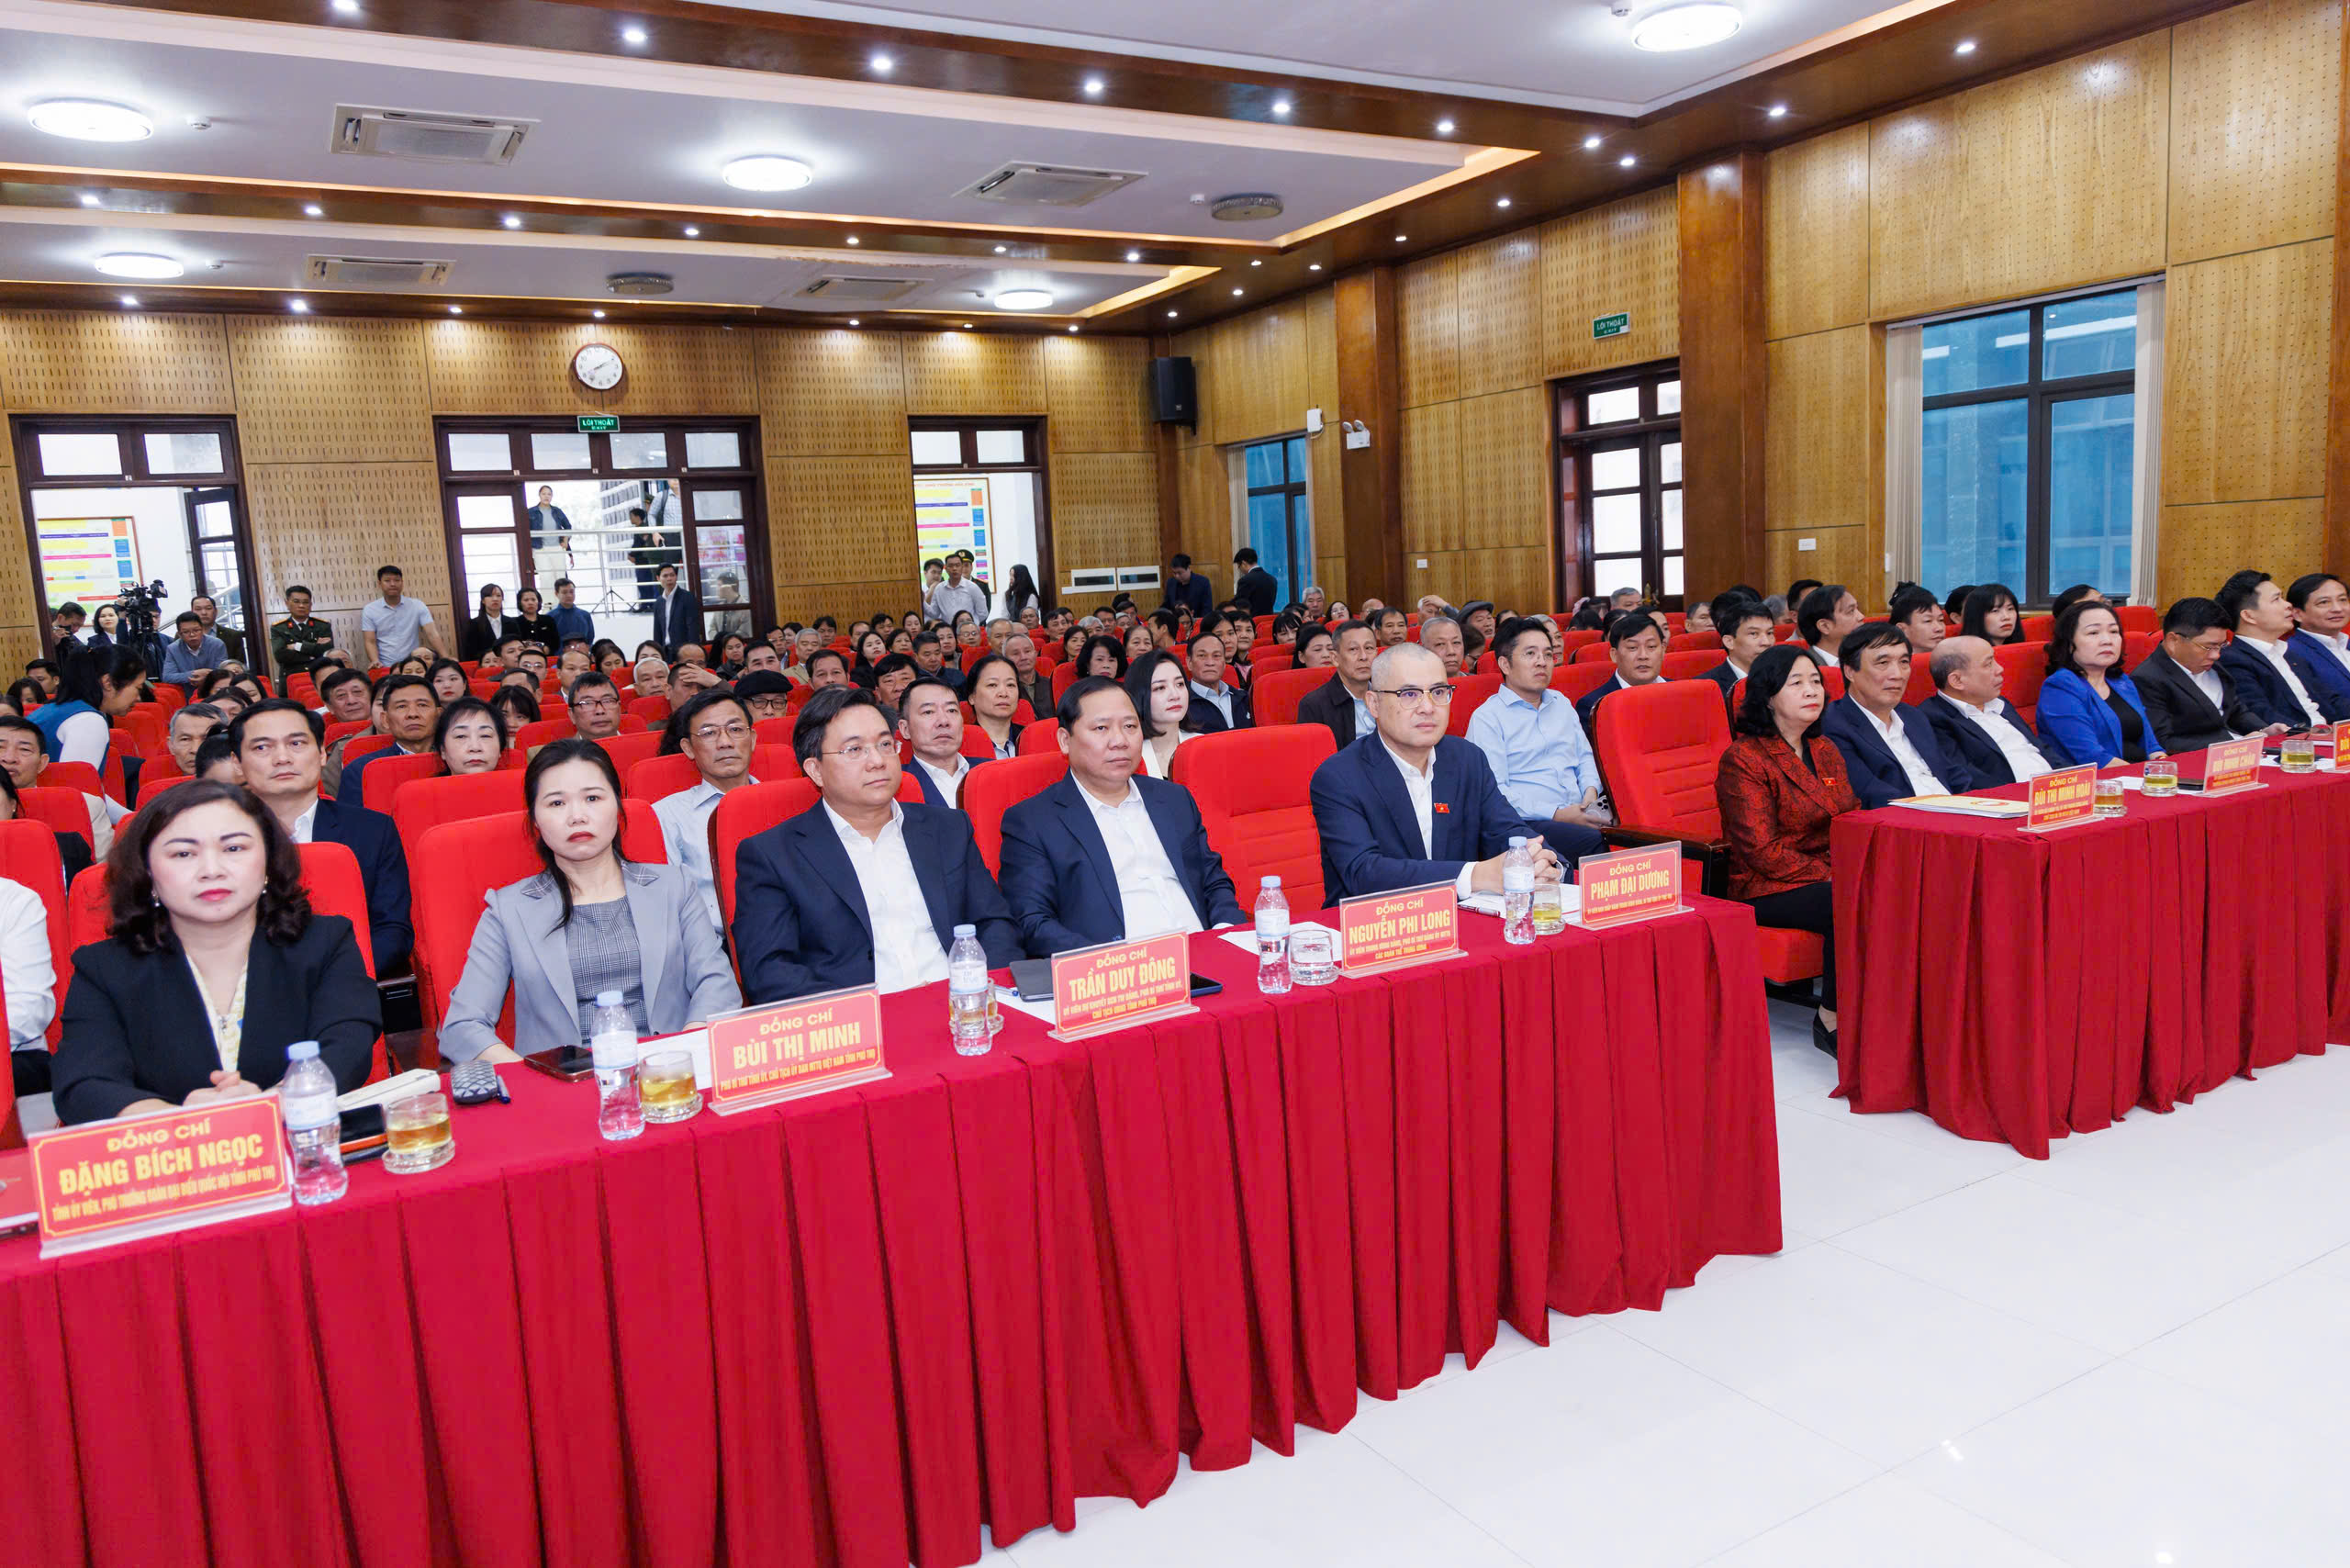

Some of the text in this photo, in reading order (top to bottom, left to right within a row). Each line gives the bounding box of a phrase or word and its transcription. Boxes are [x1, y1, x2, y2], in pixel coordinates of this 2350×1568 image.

[1609, 858, 1651, 876] ĐỒNG CHÍ
[1591, 869, 1669, 902] PHẠM ĐẠI DƯƠNG
[1376, 897, 1424, 915] ĐỒNG CHÍ
[1348, 910, 1450, 945] NGUYỄN PHI LONG
[1096, 947, 1147, 969] ĐỒNG CHÍ
[1069, 958, 1176, 1002] TRẦN DUY ĐÔNG
[760, 1007, 833, 1036] ĐỒNG CHÍ
[733, 1022, 860, 1070] BÙI THỊ MINH
[106, 1117, 211, 1152] ĐỒNG CHÍ
[59, 1159, 129, 1196] ĐẶNG
[135, 1148, 193, 1181] BÍCH
[198, 1134, 263, 1168] NGỌC
